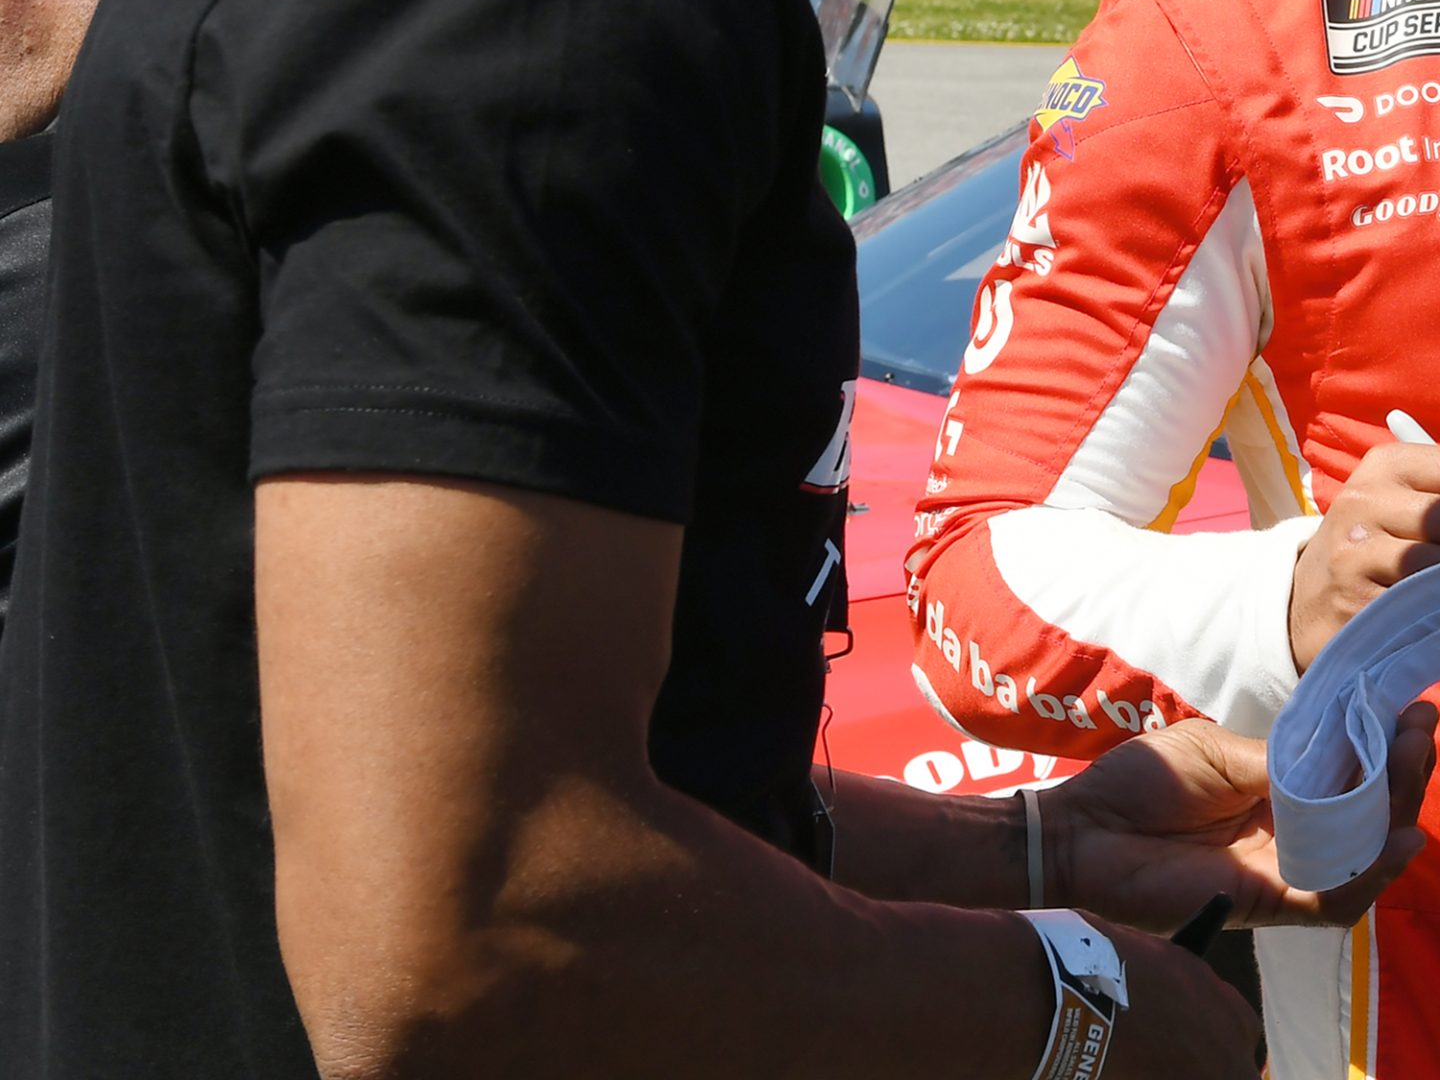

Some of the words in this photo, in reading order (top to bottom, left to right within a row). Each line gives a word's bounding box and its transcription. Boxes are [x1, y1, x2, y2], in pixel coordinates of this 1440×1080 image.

[1353, 23, 1398, 53] CUP
[1323, 136, 1417, 181] Root
[925, 600, 961, 674] da
[969, 639, 1019, 715] ba
